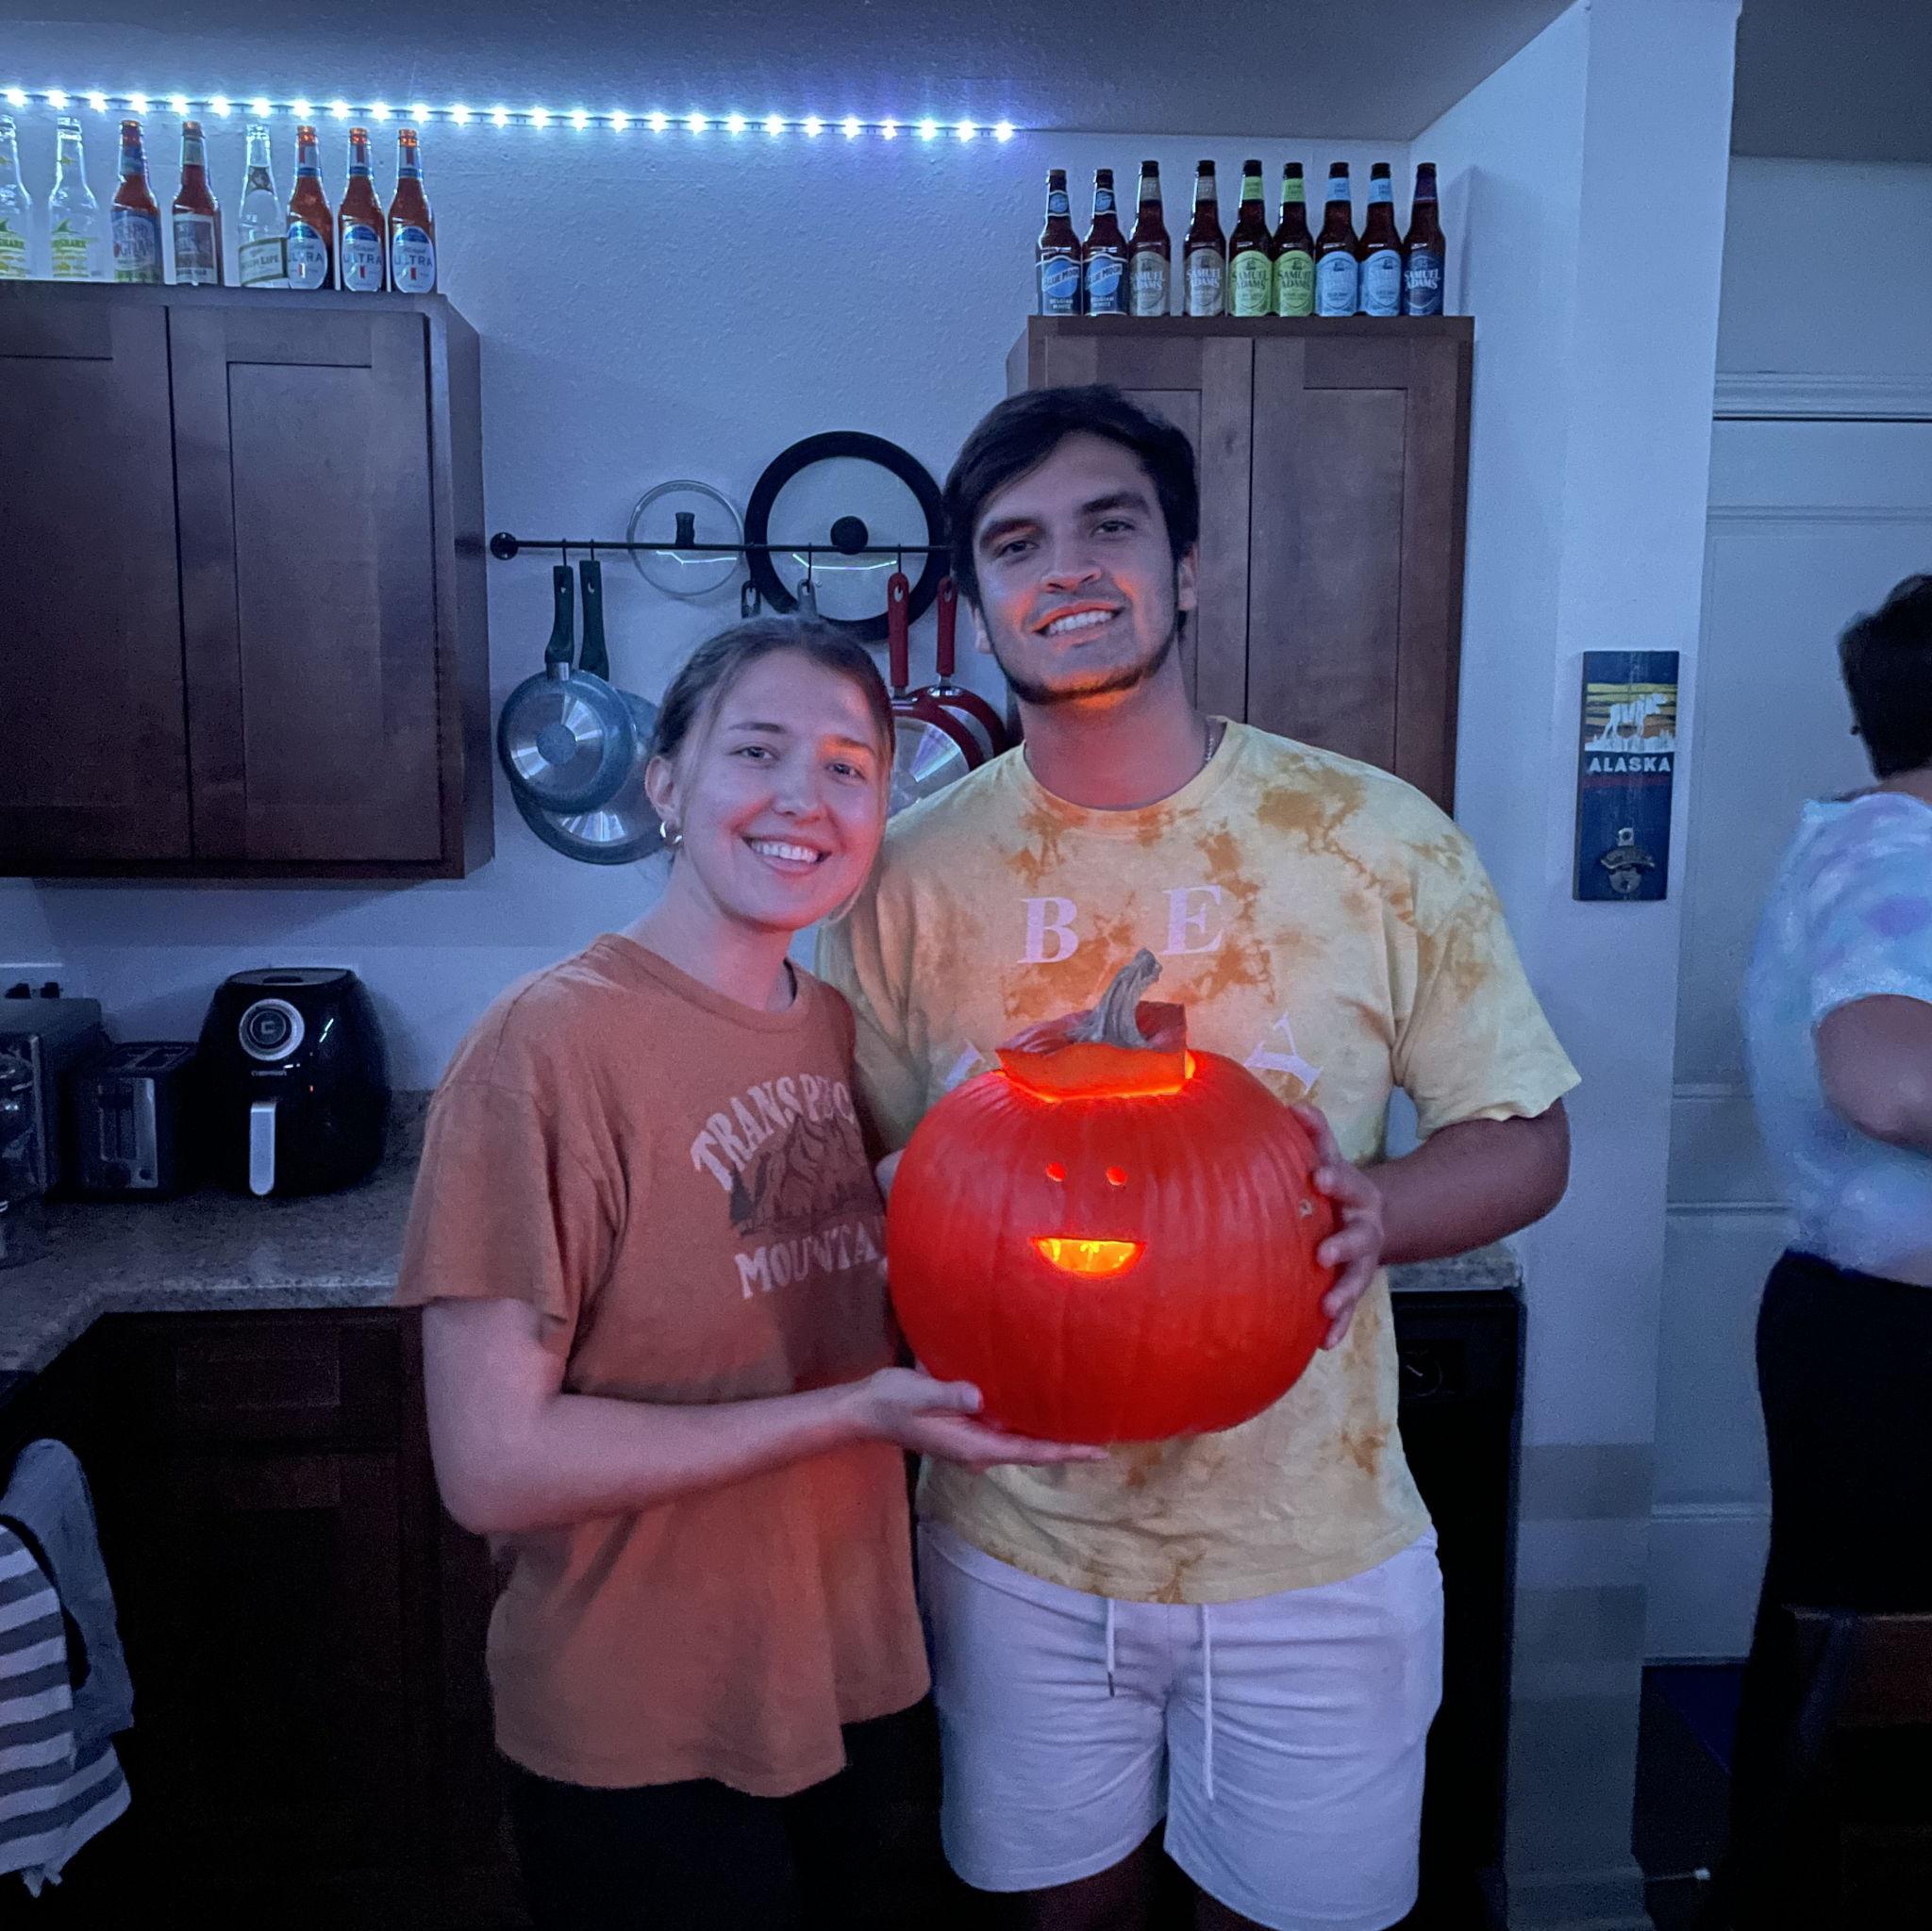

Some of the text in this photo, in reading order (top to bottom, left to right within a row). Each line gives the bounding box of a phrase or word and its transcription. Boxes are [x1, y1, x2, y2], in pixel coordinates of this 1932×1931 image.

[288, 252, 324, 262] LRA
[1231, 270, 1269, 282] SAMUEL
[1277, 270, 1313, 281] SAMUEL
[1404, 268, 1441, 282] SAMUEL
[1237, 279, 1266, 291] ADAMS
[1407, 279, 1438, 290] ADAMS
[1589, 757, 1671, 773] ALASKA
[1017, 885, 1224, 963] B E
[734, 1222, 888, 1299] MOUNTA
